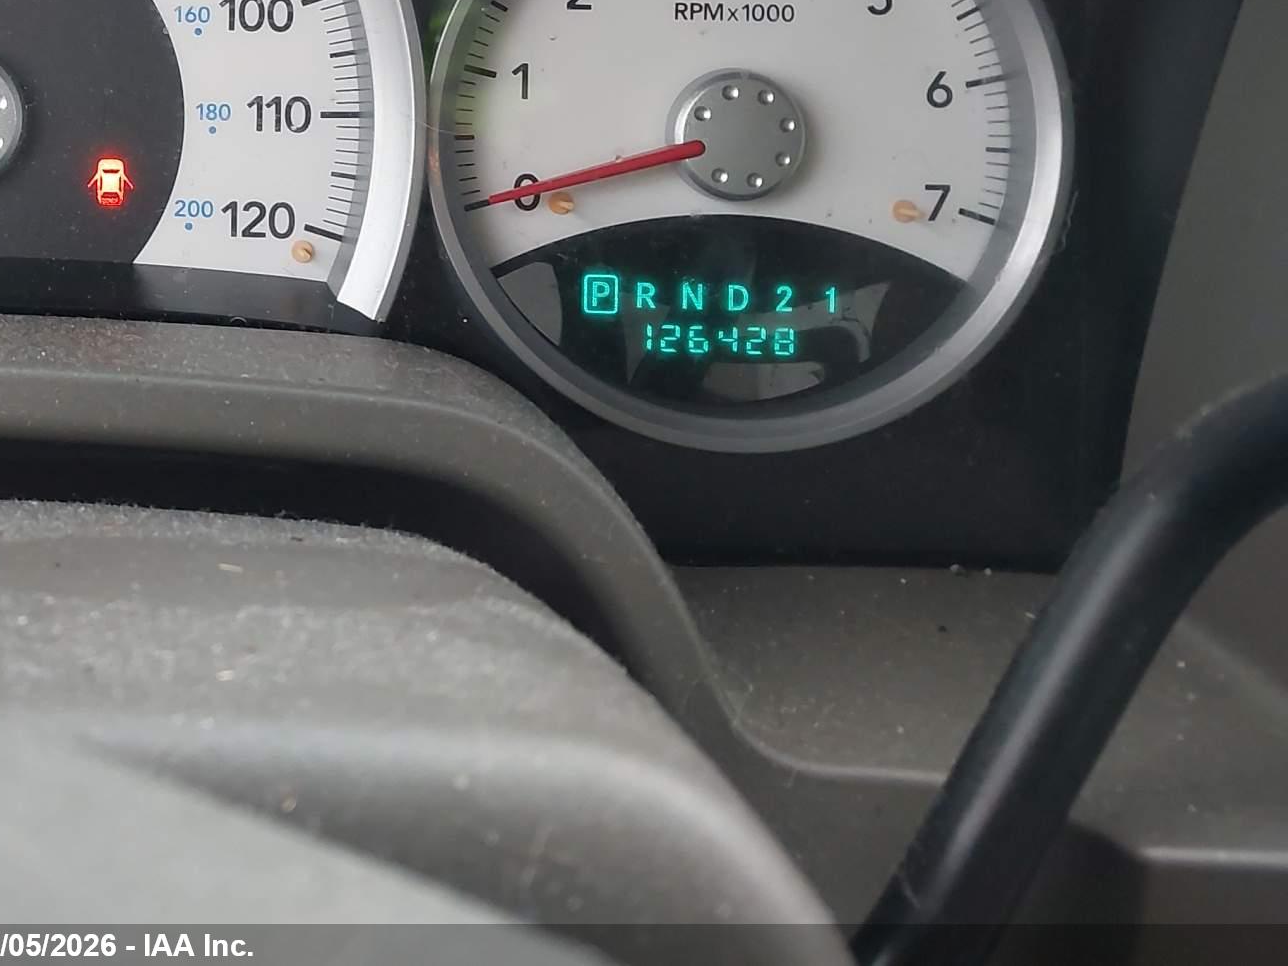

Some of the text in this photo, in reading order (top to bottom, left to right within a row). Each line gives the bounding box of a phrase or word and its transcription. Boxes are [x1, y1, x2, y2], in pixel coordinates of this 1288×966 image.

[175, 5, 211, 24] 160
[512, 63, 528, 99] 1
[927, 71, 952, 108] 6
[197, 103, 232, 122] 180
[247, 96, 311, 133] 110
[172, 198, 217, 220] 200
[514, 174, 541, 211] 0
[925, 185, 950, 221] 7
[222, 201, 295, 239] 120
[591, 281, 835, 313] P R N D 2 1
[646, 324, 794, 355] 126428
